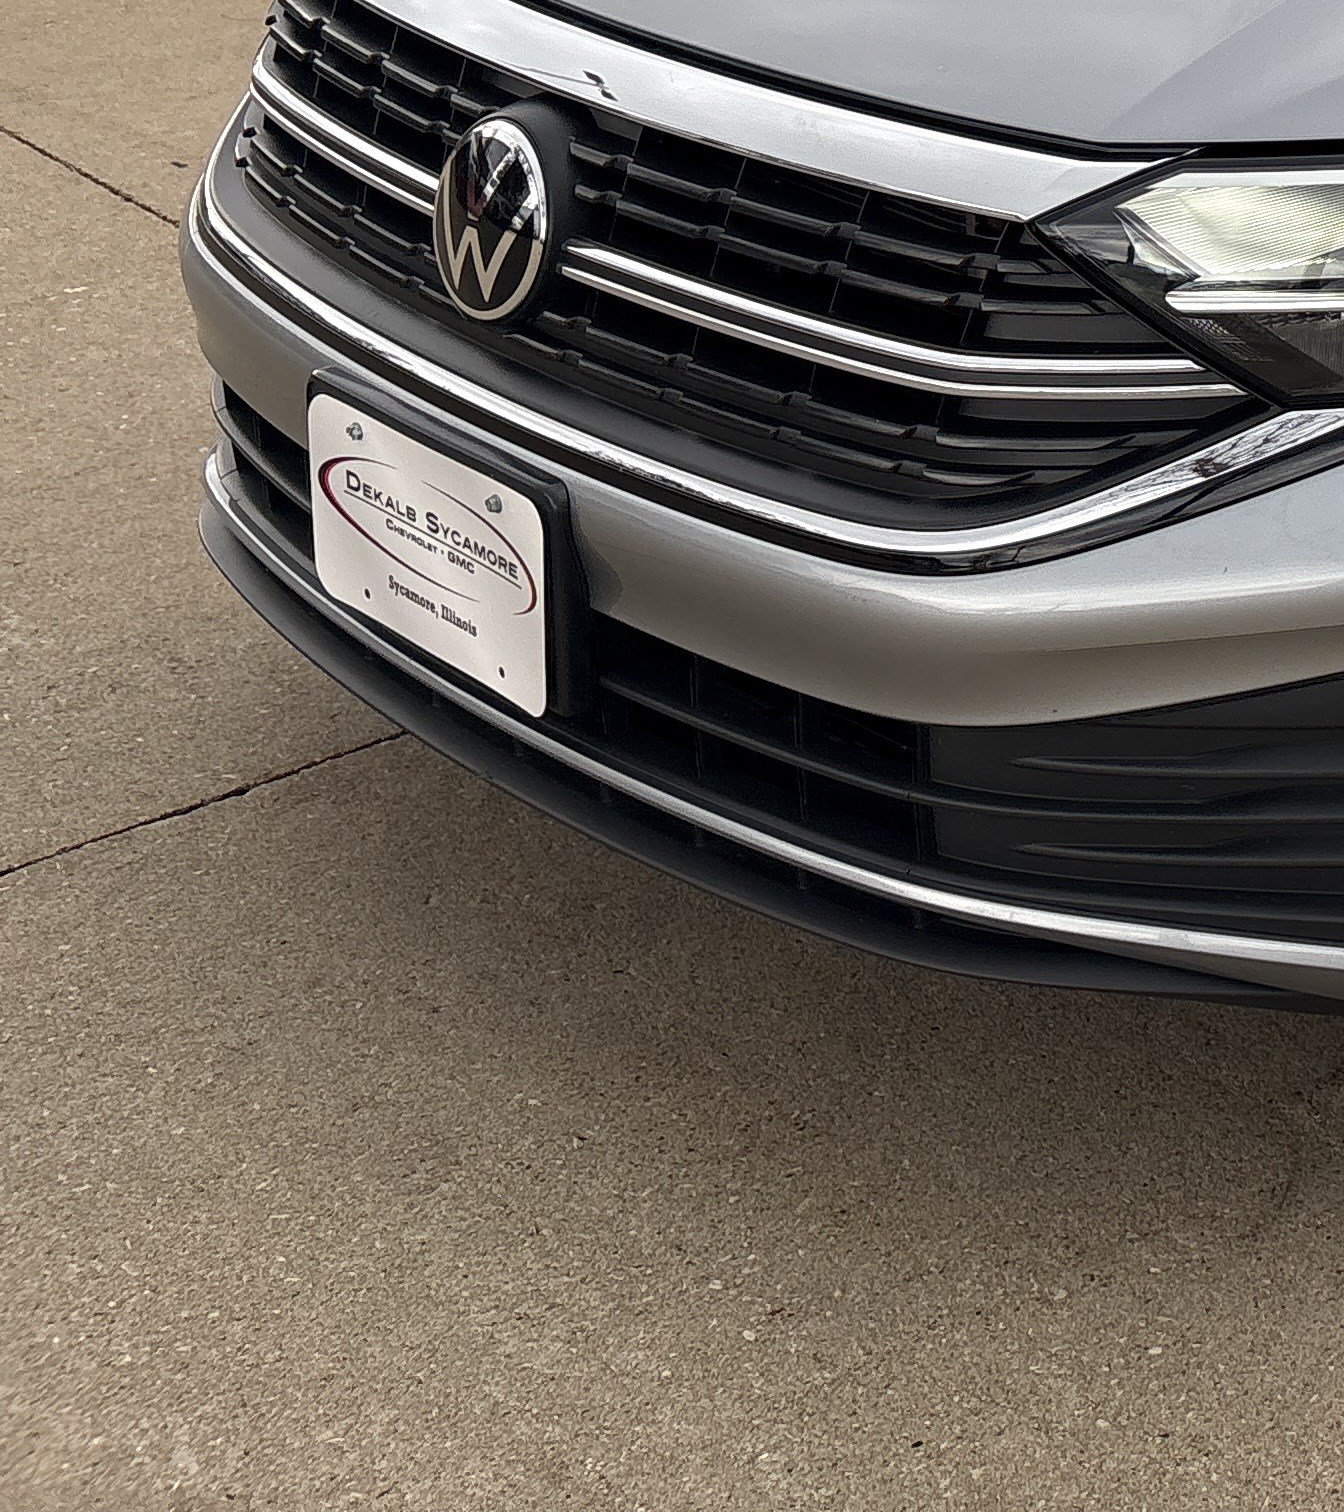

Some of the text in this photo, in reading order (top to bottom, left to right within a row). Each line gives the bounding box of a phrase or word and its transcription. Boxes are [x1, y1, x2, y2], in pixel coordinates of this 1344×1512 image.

[425, 511, 519, 581] SYCAMORE
[447, 550, 475, 575] GMC
[388, 574, 478, 638] Sycamore, Illinois
